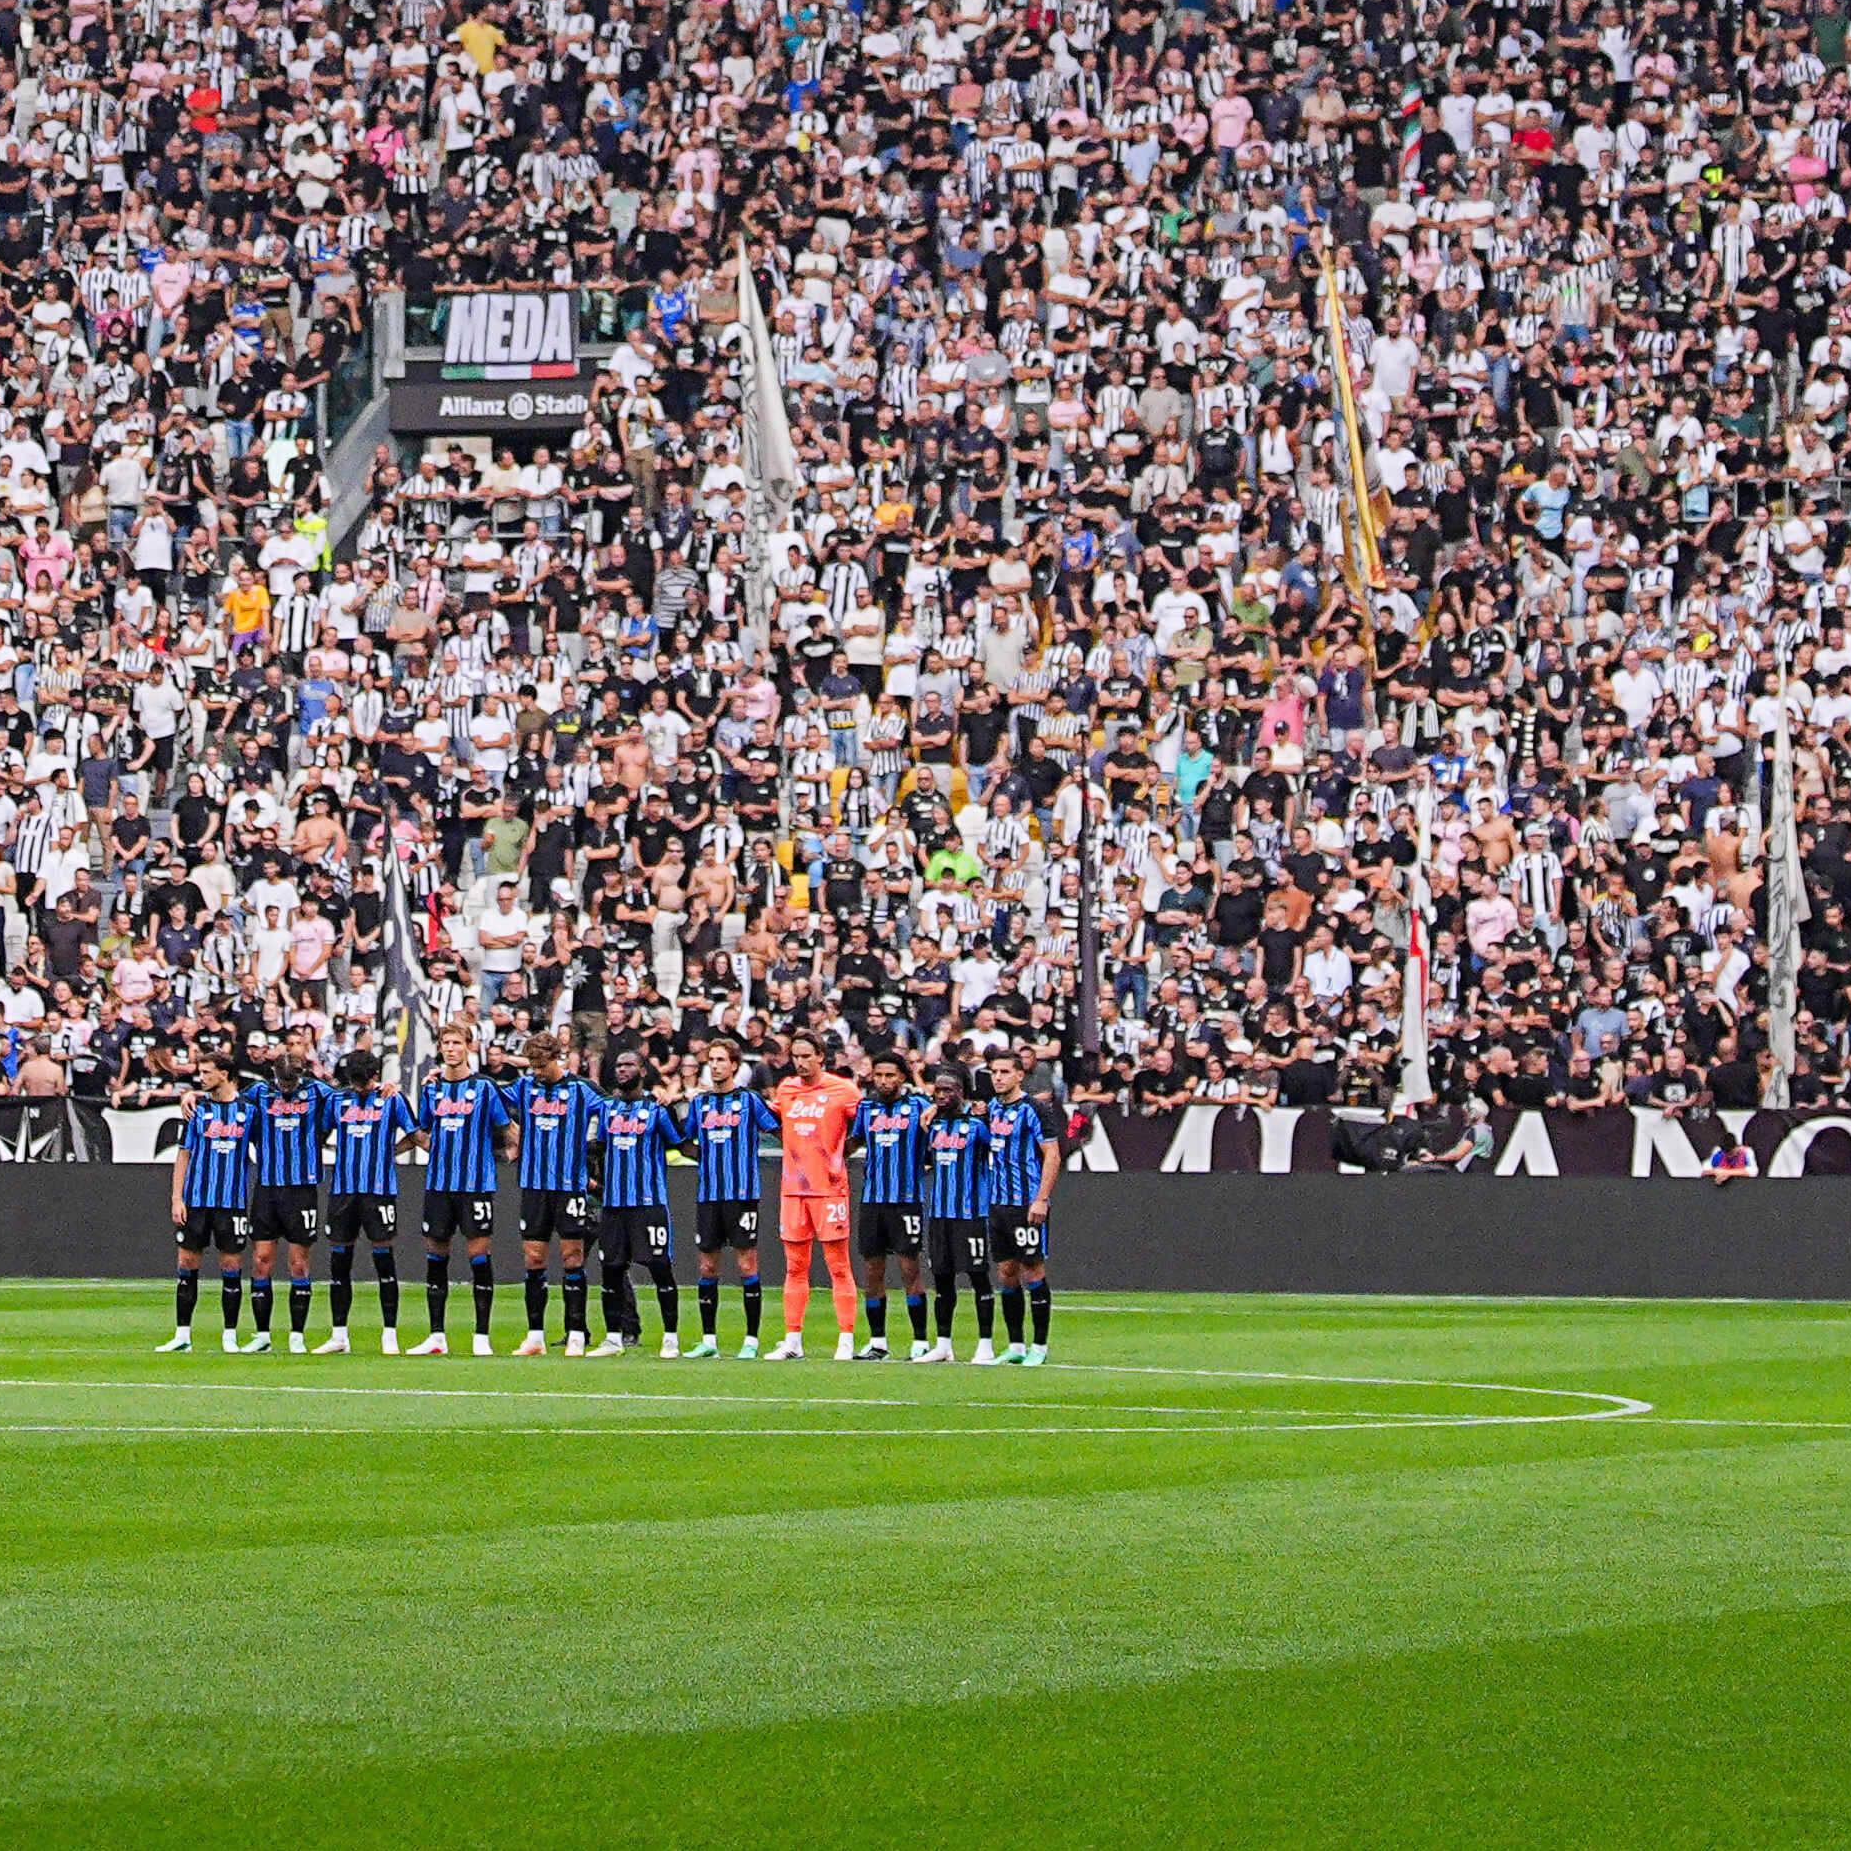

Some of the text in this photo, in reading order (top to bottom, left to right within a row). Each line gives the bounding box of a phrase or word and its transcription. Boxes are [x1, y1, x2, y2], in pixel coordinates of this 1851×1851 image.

[444, 292, 574, 364] MEDA
[439, 397, 506, 417] Allianz
[267, 1098, 310, 1116] Lete
[340, 1105, 383, 1123] Lete
[433, 1098, 474, 1116] Lete
[529, 1097, 568, 1115] Lete
[787, 1101, 825, 1119] Lete
[203, 1120, 245, 1138] Lete
[607, 1115, 647, 1134] Lete
[701, 1110, 742, 1129] Lete
[868, 1114, 910, 1132] Lete
[932, 1131, 969, 1150] Lete
[473, 1201, 493, 1220] 31
[566, 1197, 587, 1217] 42
[301, 1209, 318, 1229] 17
[739, 1211, 758, 1231] 47
[902, 1215, 921, 1235] 13
[648, 1225, 668, 1246] 19
[1014, 1226, 1040, 1246] 90
[967, 1237, 985, 1257] 11
